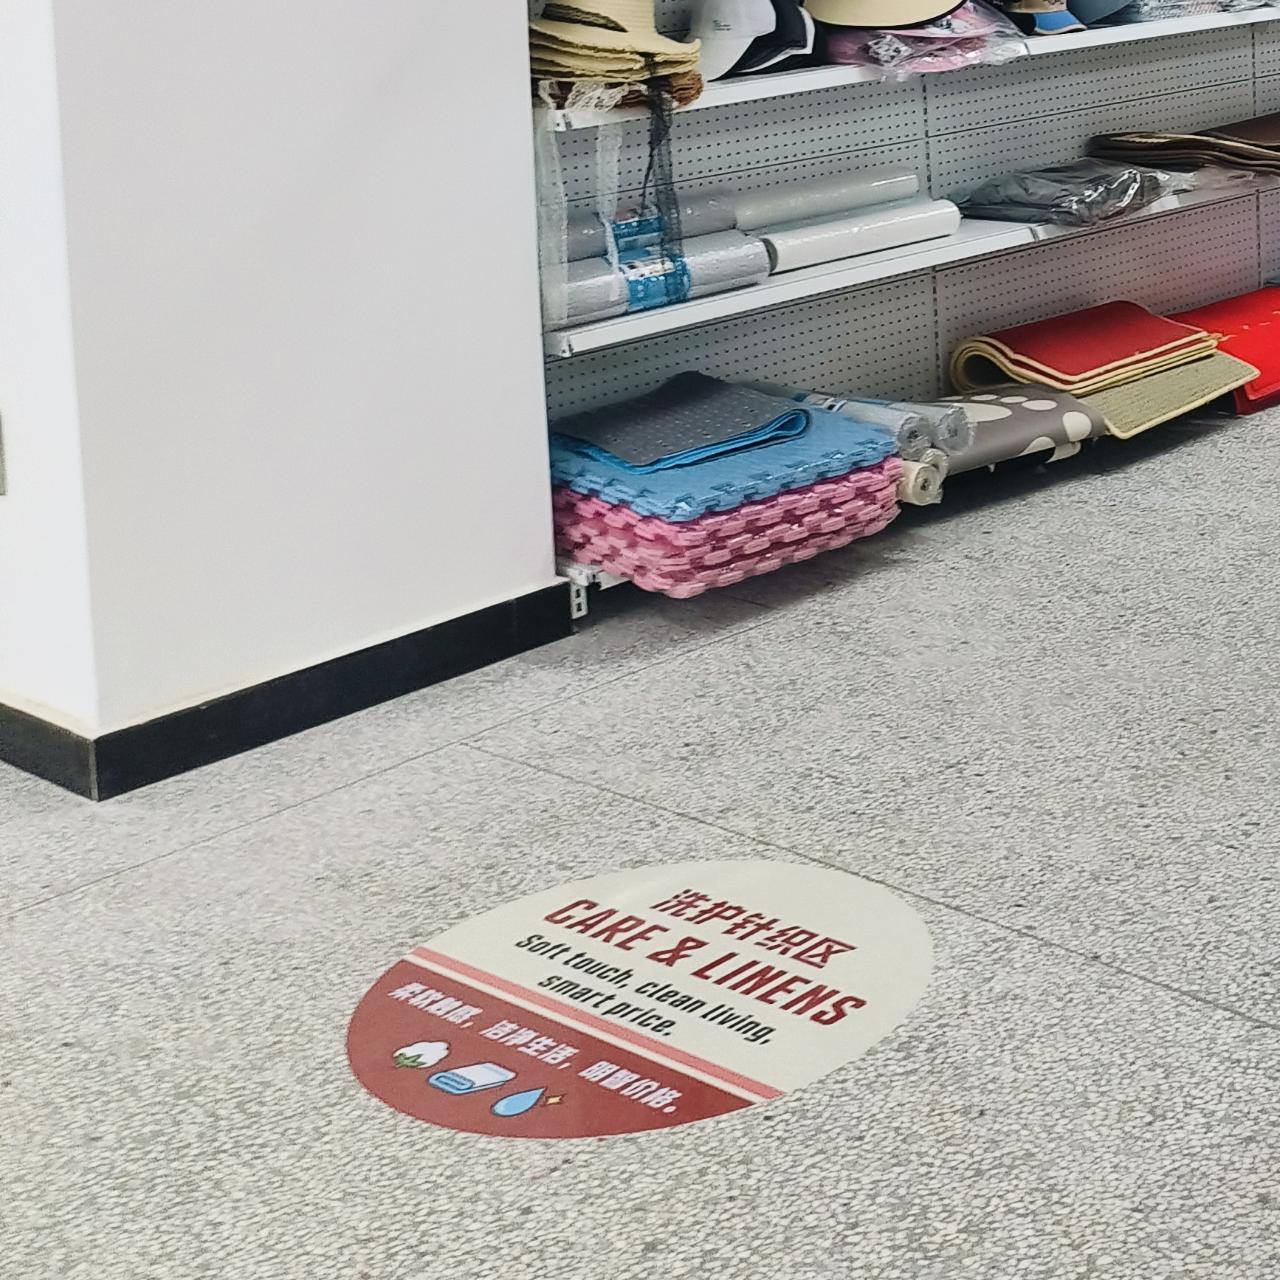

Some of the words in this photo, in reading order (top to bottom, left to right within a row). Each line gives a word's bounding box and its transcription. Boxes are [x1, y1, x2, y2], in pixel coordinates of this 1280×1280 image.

[543, 898, 671, 951] CARE
[645, 936, 710, 968] &
[690, 952, 868, 1026] LINENS
[649, 888, 857, 969] 洗护针织区
[515, 934, 571, 961] Soft
[563, 950, 635, 990] touch,
[635, 979, 707, 1015] clean
[699, 1003, 777, 1046] living,
[537, 975, 616, 1010] smart
[608, 1000, 681, 1037] price.
